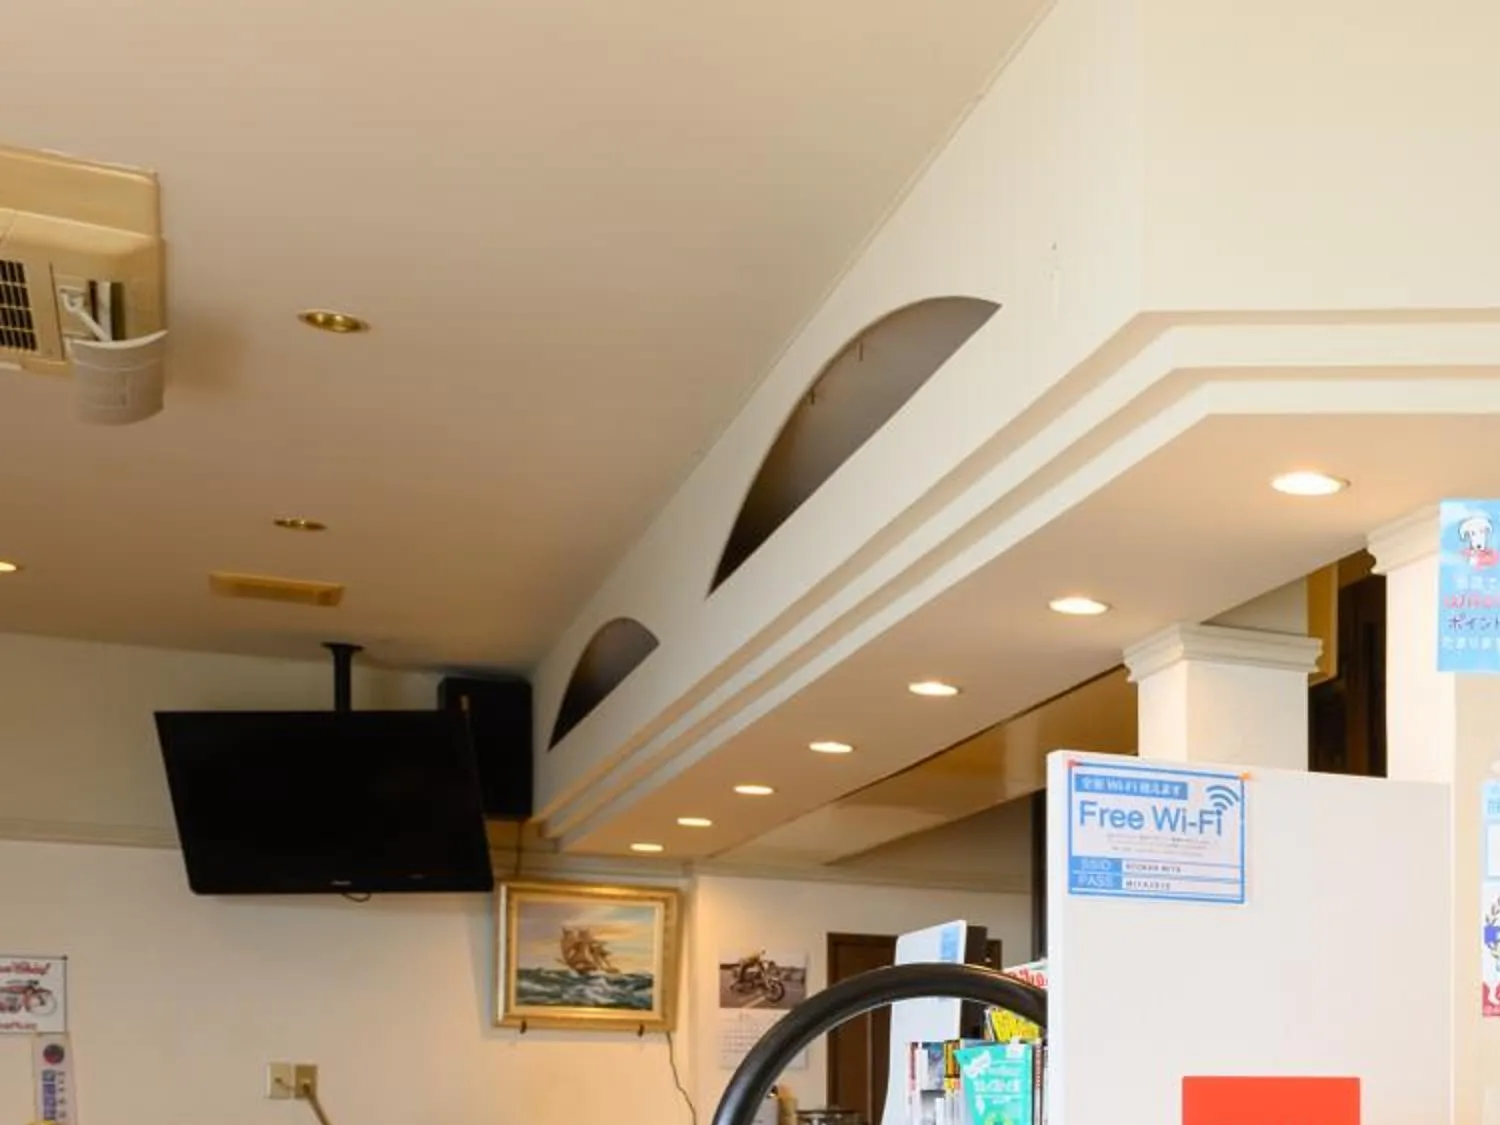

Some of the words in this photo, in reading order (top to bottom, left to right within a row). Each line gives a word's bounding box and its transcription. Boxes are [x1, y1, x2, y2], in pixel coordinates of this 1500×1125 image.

[1079, 800, 1145, 831] Free
[1152, 805, 1223, 836] Wi-Fi
[1077, 873, 1114, 889] PASS
